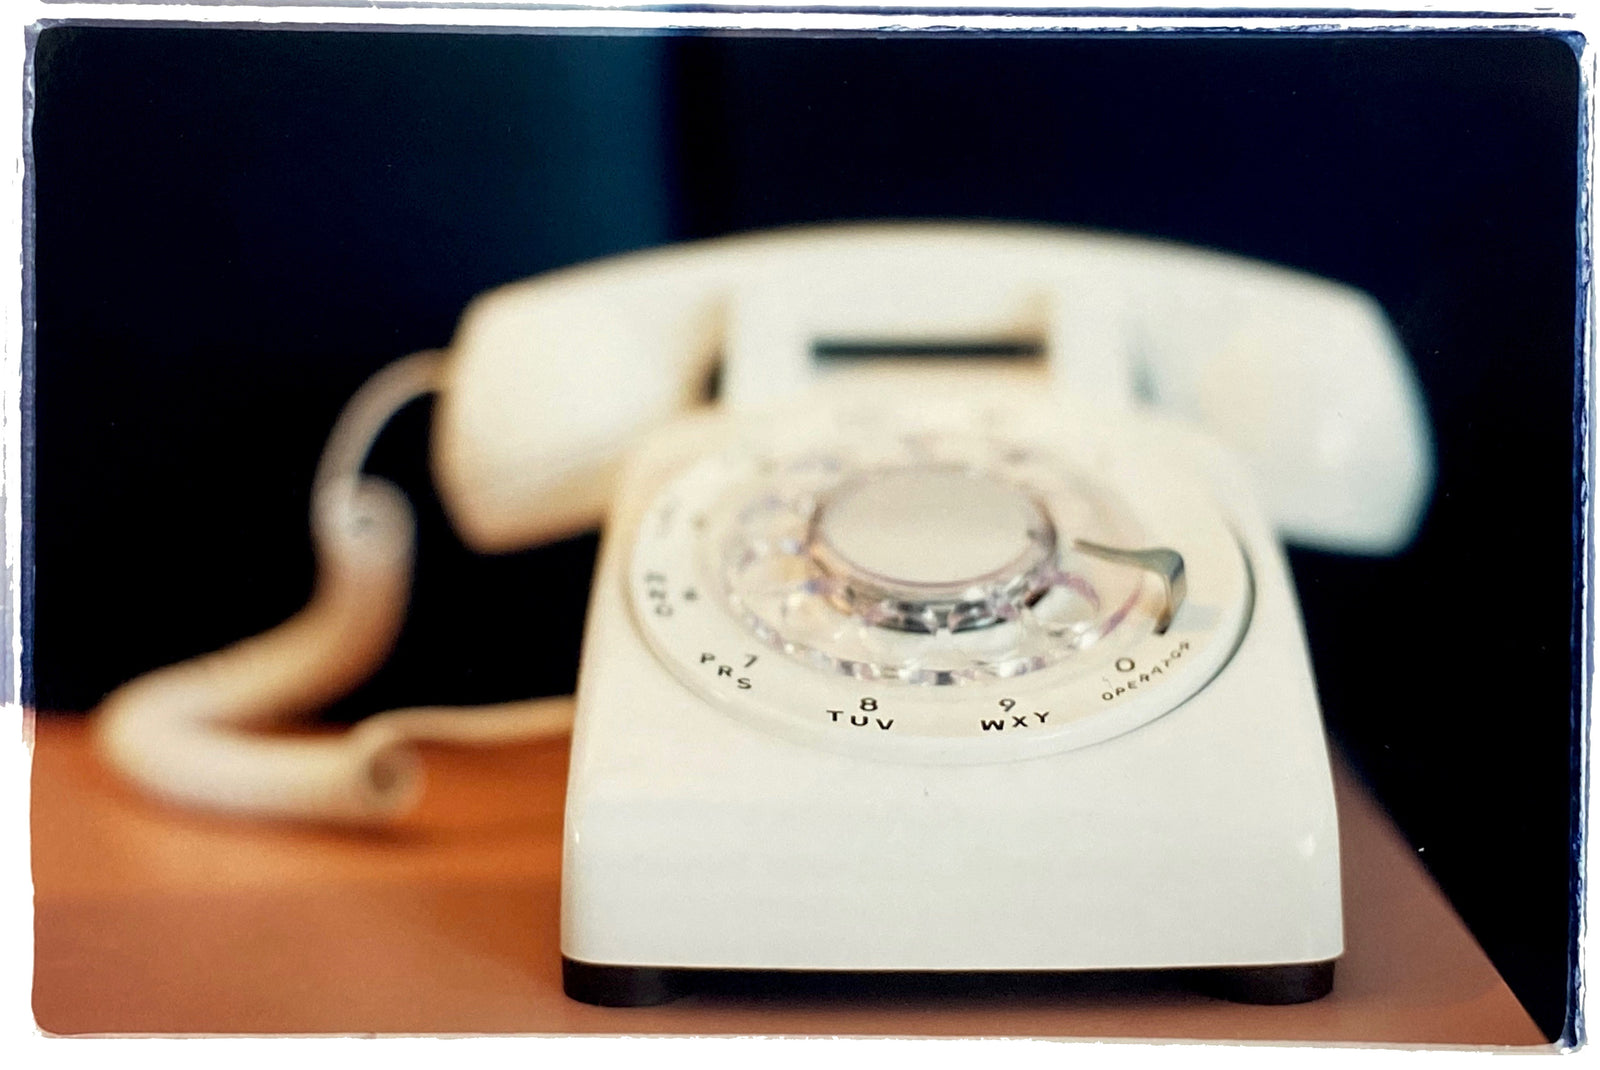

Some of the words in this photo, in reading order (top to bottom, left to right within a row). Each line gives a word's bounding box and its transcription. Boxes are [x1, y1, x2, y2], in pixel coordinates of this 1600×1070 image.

[700, 653, 752, 689] PRS
[744, 655, 758, 668] 7
[1102, 641, 1190, 701] OPERATOR
[860, 698, 878, 711] 8
[999, 699, 1016, 712] 9
[826, 710, 894, 730] TUV
[981, 712, 1050, 731] WXY
